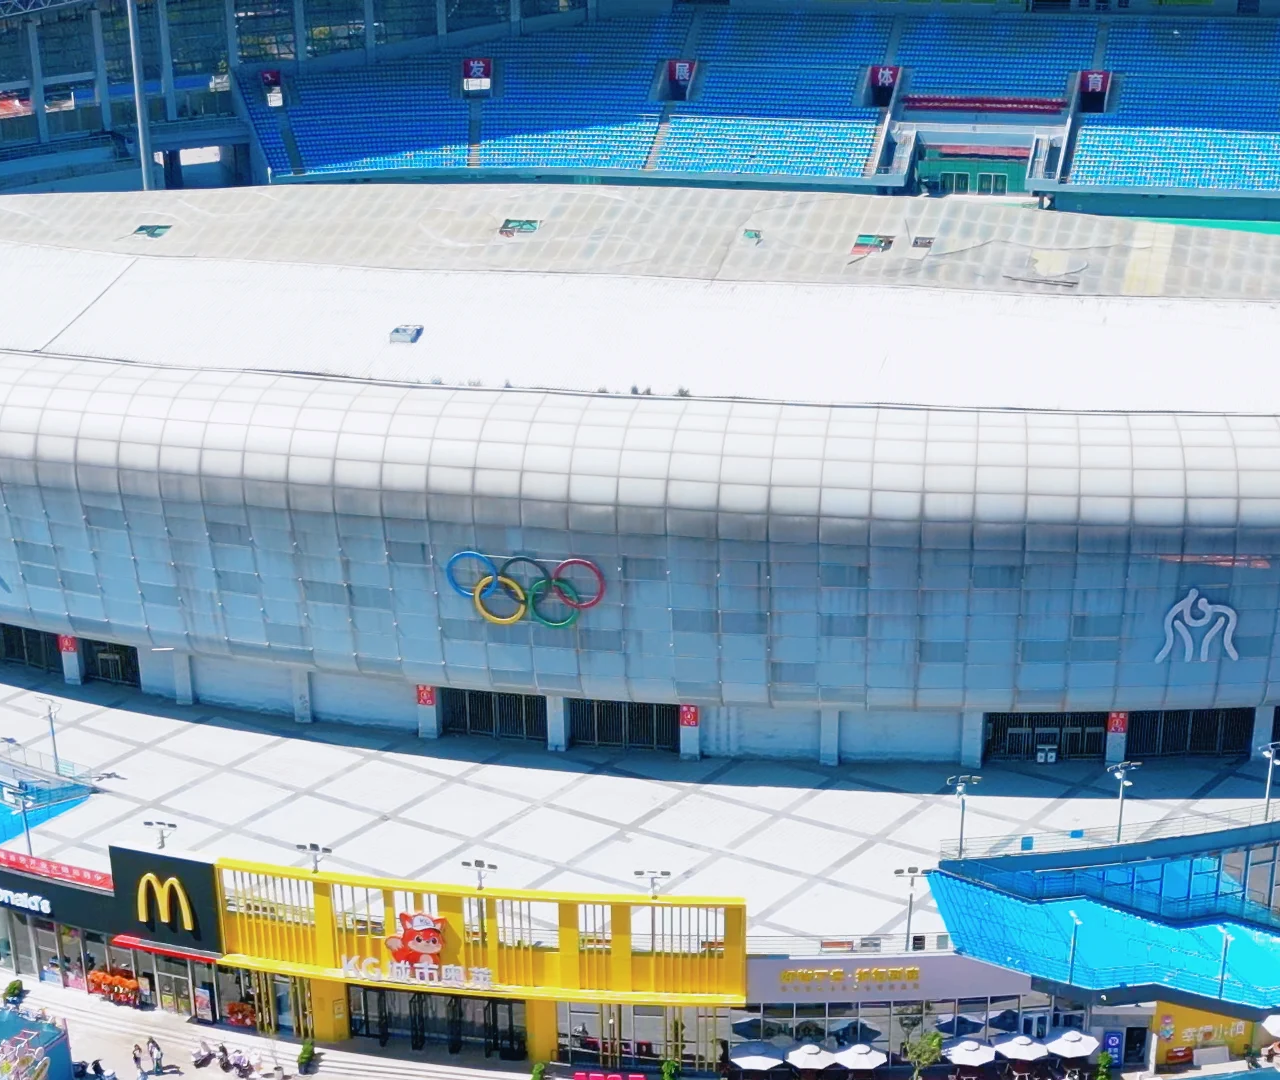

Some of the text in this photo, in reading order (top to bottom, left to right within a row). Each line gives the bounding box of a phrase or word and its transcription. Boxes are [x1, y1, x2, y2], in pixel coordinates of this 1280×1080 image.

[470, 60, 486, 77] 发
[675, 63, 690, 80] 展
[878, 68, 894, 86] 体
[1087, 73, 1104, 92] 育
[341, 954, 382, 982] KG
